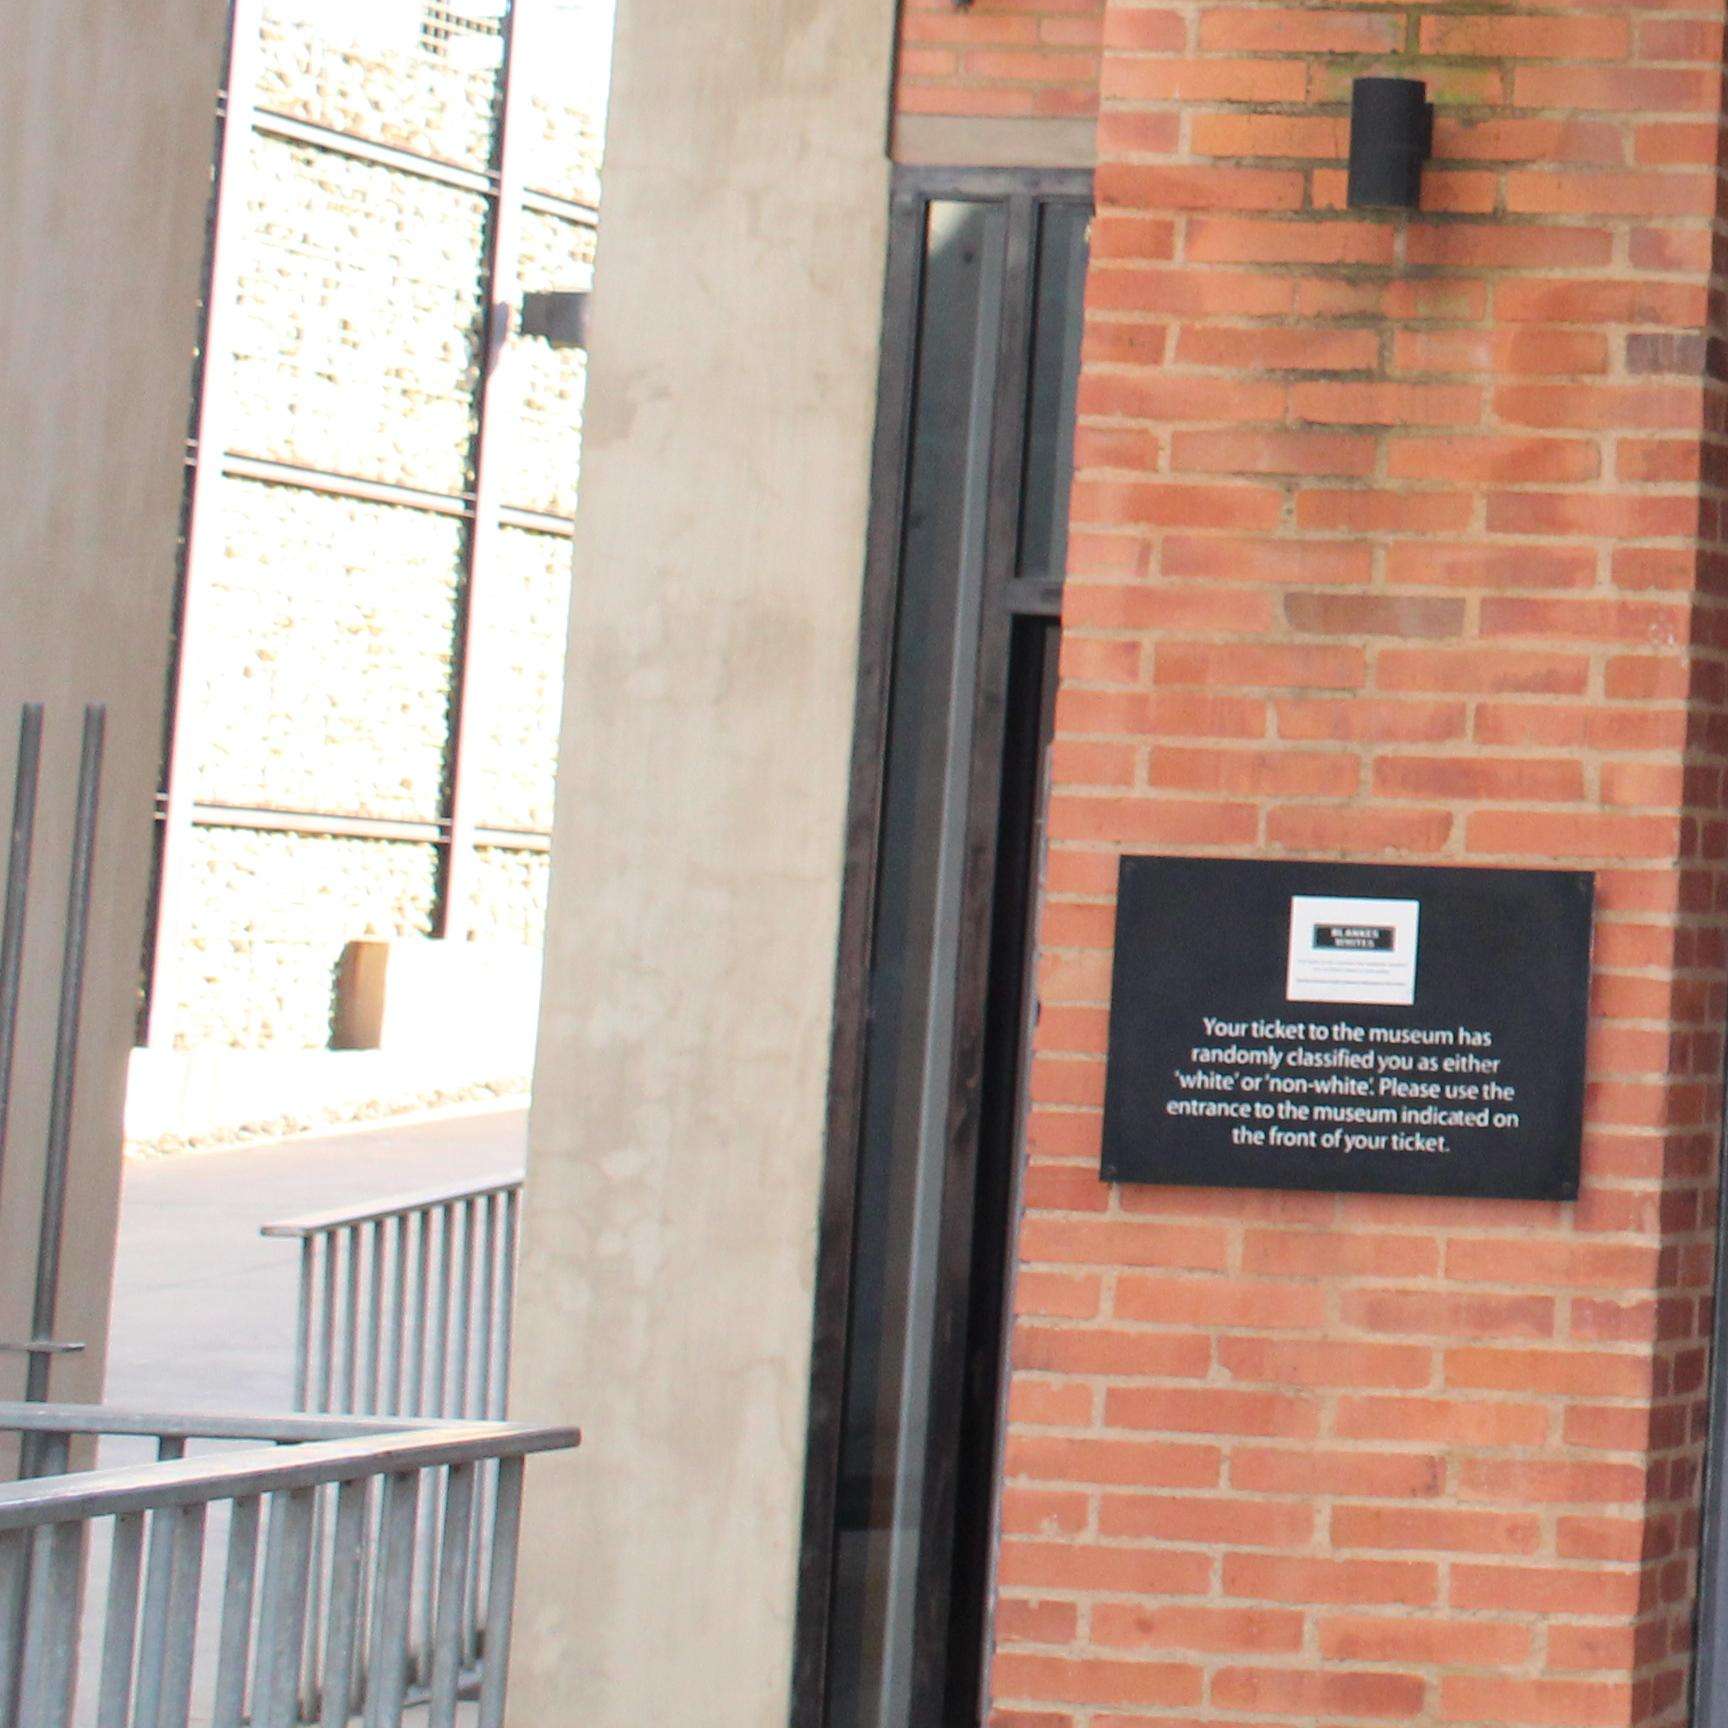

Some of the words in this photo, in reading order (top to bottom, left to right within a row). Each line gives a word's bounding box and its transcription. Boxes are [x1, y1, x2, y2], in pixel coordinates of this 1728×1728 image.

[1202, 1017, 1247, 1037] Your
[1251, 1019, 1305, 1040] ticket
[1308, 1022, 1329, 1041] to
[1332, 1022, 1365, 1042] the
[1368, 1026, 1454, 1045] museum
[1458, 1026, 1492, 1047] has
[1190, 1044, 1283, 1070] randomly
[1286, 1046, 1375, 1069] classified
[1377, 1054, 1414, 1074] you
[1417, 1056, 1439, 1072] as
[1442, 1053, 1500, 1073] either
[1240, 1075, 1263, 1092] or
[1379, 1077, 1441, 1099] Please
[1445, 1084, 1479, 1100] use
[1482, 1081, 1515, 1101] the
[1167, 1099, 1251, 1118] entrance
[1254, 1102, 1275, 1119] to
[1277, 1100, 1309, 1120] the
[1313, 1105, 1397, 1123] museum
[1402, 1105, 1489, 1127] indicated
[1492, 1112, 1519, 1128] on
[1232, 1125, 1265, 1146] the
[1268, 1125, 1316, 1148] front
[1320, 1127, 1343, 1148] of
[1344, 1133, 1387, 1153] your
[1391, 1132, 1450, 1153] ticket.
